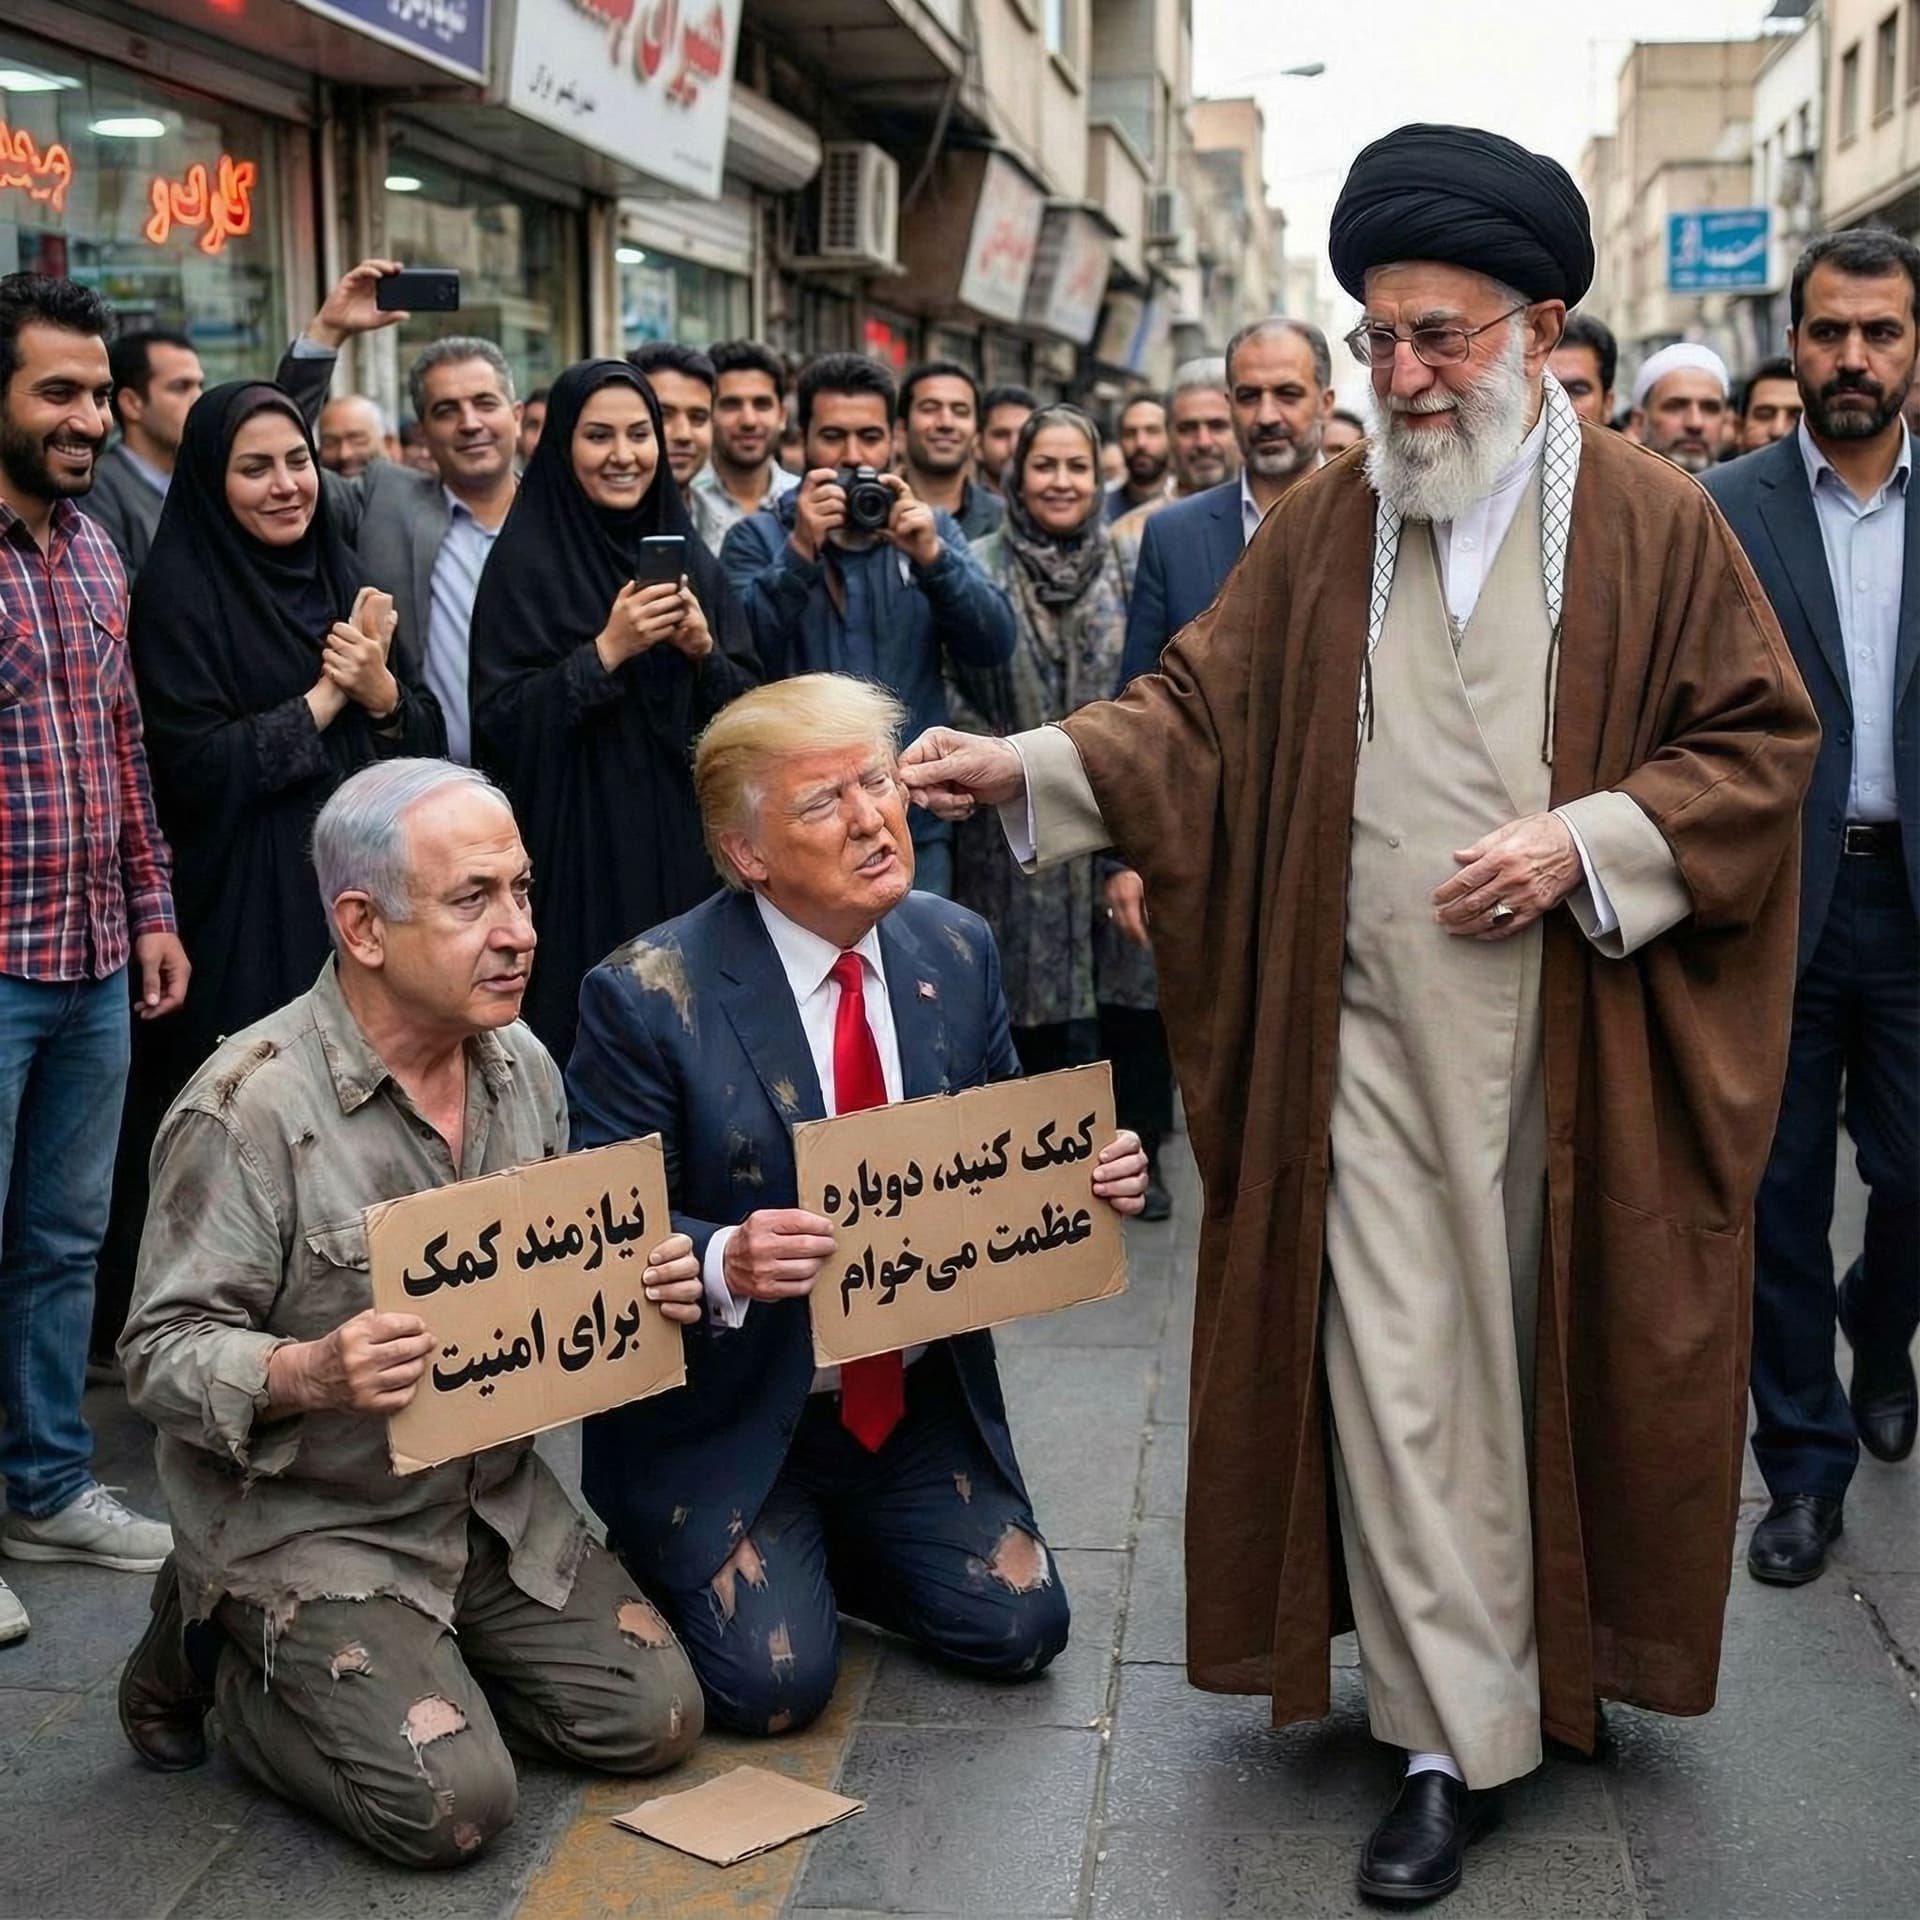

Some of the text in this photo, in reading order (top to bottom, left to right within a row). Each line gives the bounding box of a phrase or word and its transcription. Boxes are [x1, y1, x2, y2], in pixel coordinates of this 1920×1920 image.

[824, 1112, 1096, 1227] کمک کنید، دوباره
[403, 1187, 645, 1296] نیازمند کمک
[987, 1202, 1092, 1263] عظمت
[432, 1290, 640, 1396] برای امنیت
